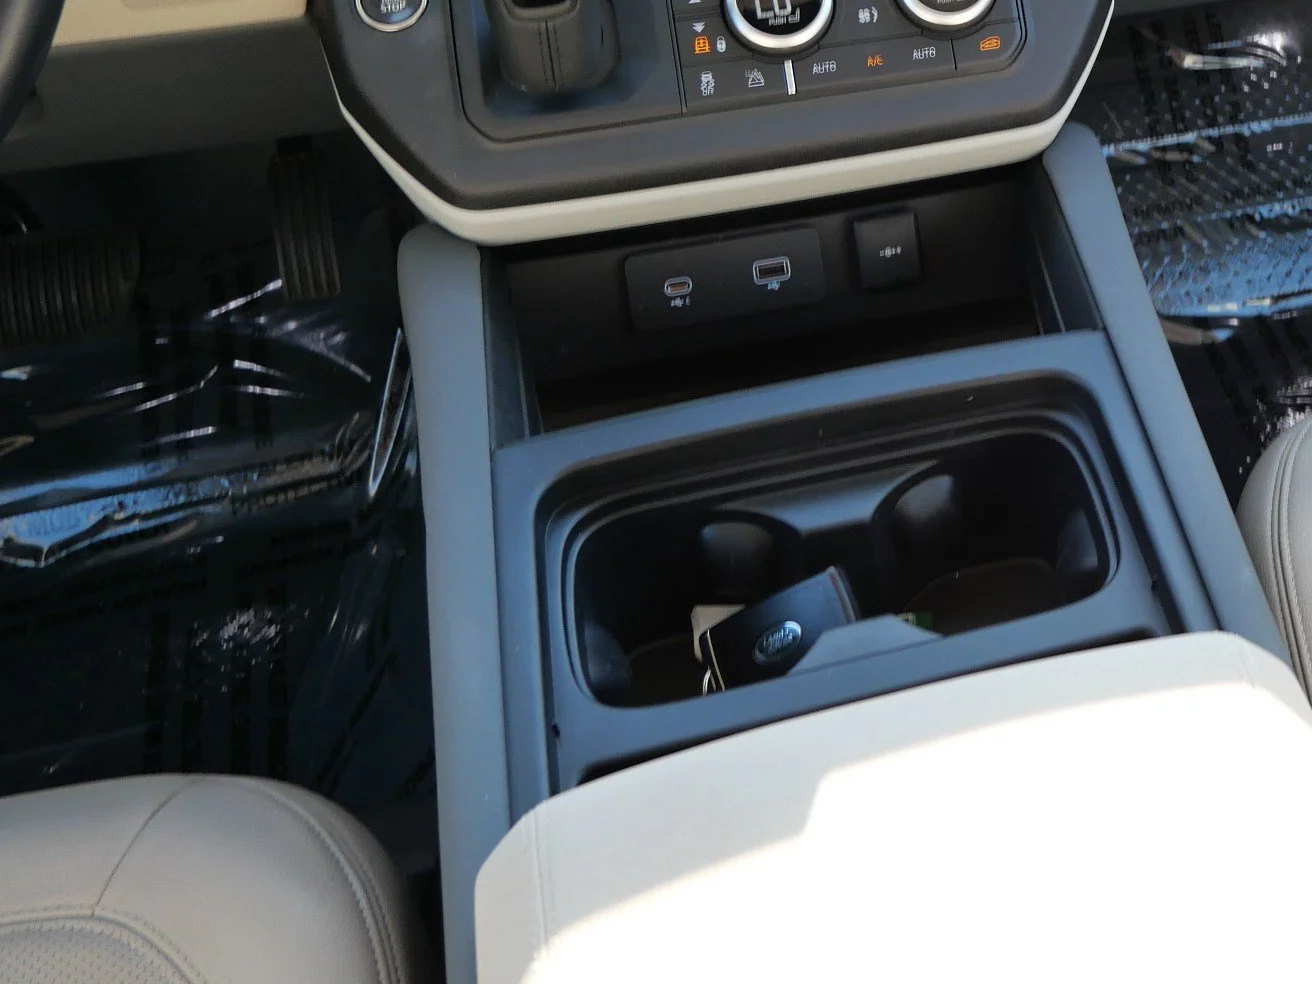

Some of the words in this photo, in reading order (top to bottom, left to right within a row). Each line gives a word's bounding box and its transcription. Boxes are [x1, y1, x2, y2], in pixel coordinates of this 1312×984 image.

[380, 1, 406, 14] STOP
[912, 46, 936, 60] AUTO
[867, 55, 884, 67] A/C
[812, 61, 837, 75] AUTO
